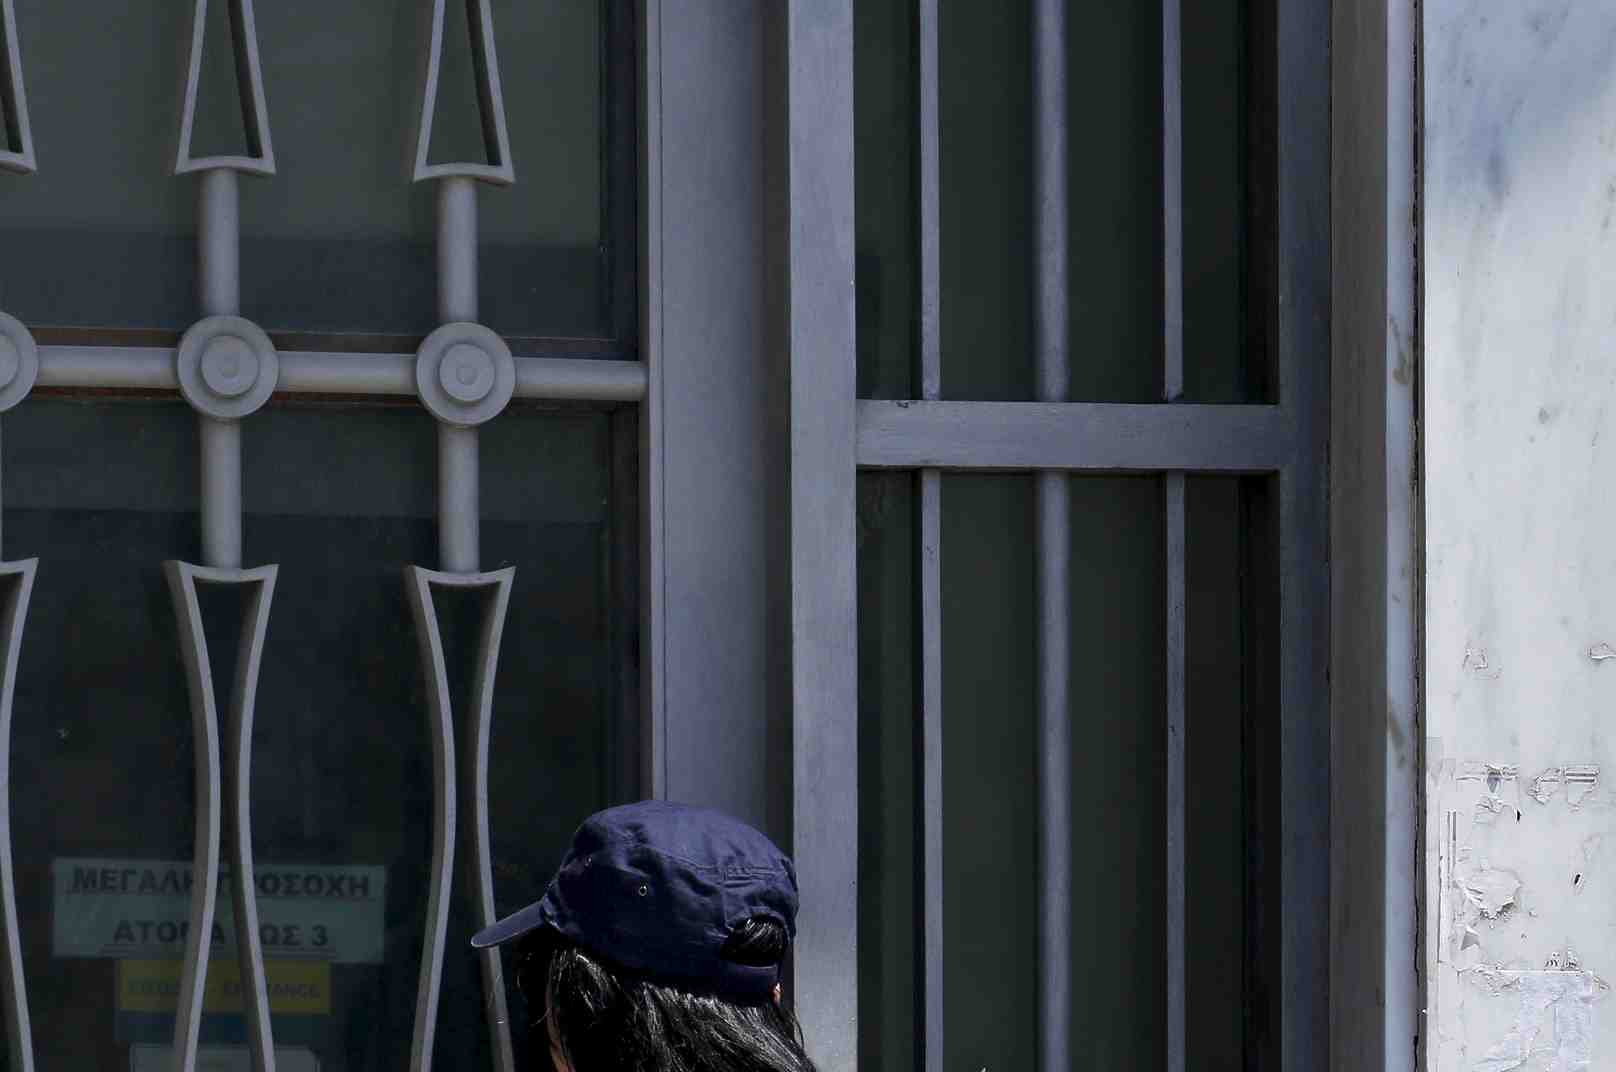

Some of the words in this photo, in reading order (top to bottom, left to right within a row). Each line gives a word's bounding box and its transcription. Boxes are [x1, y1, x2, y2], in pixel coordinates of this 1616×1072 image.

[217, 870, 369, 897] ΠΟΣΟΧΗ
[237, 923, 304, 946] ΩΣ
[311, 925, 329, 947] 3
